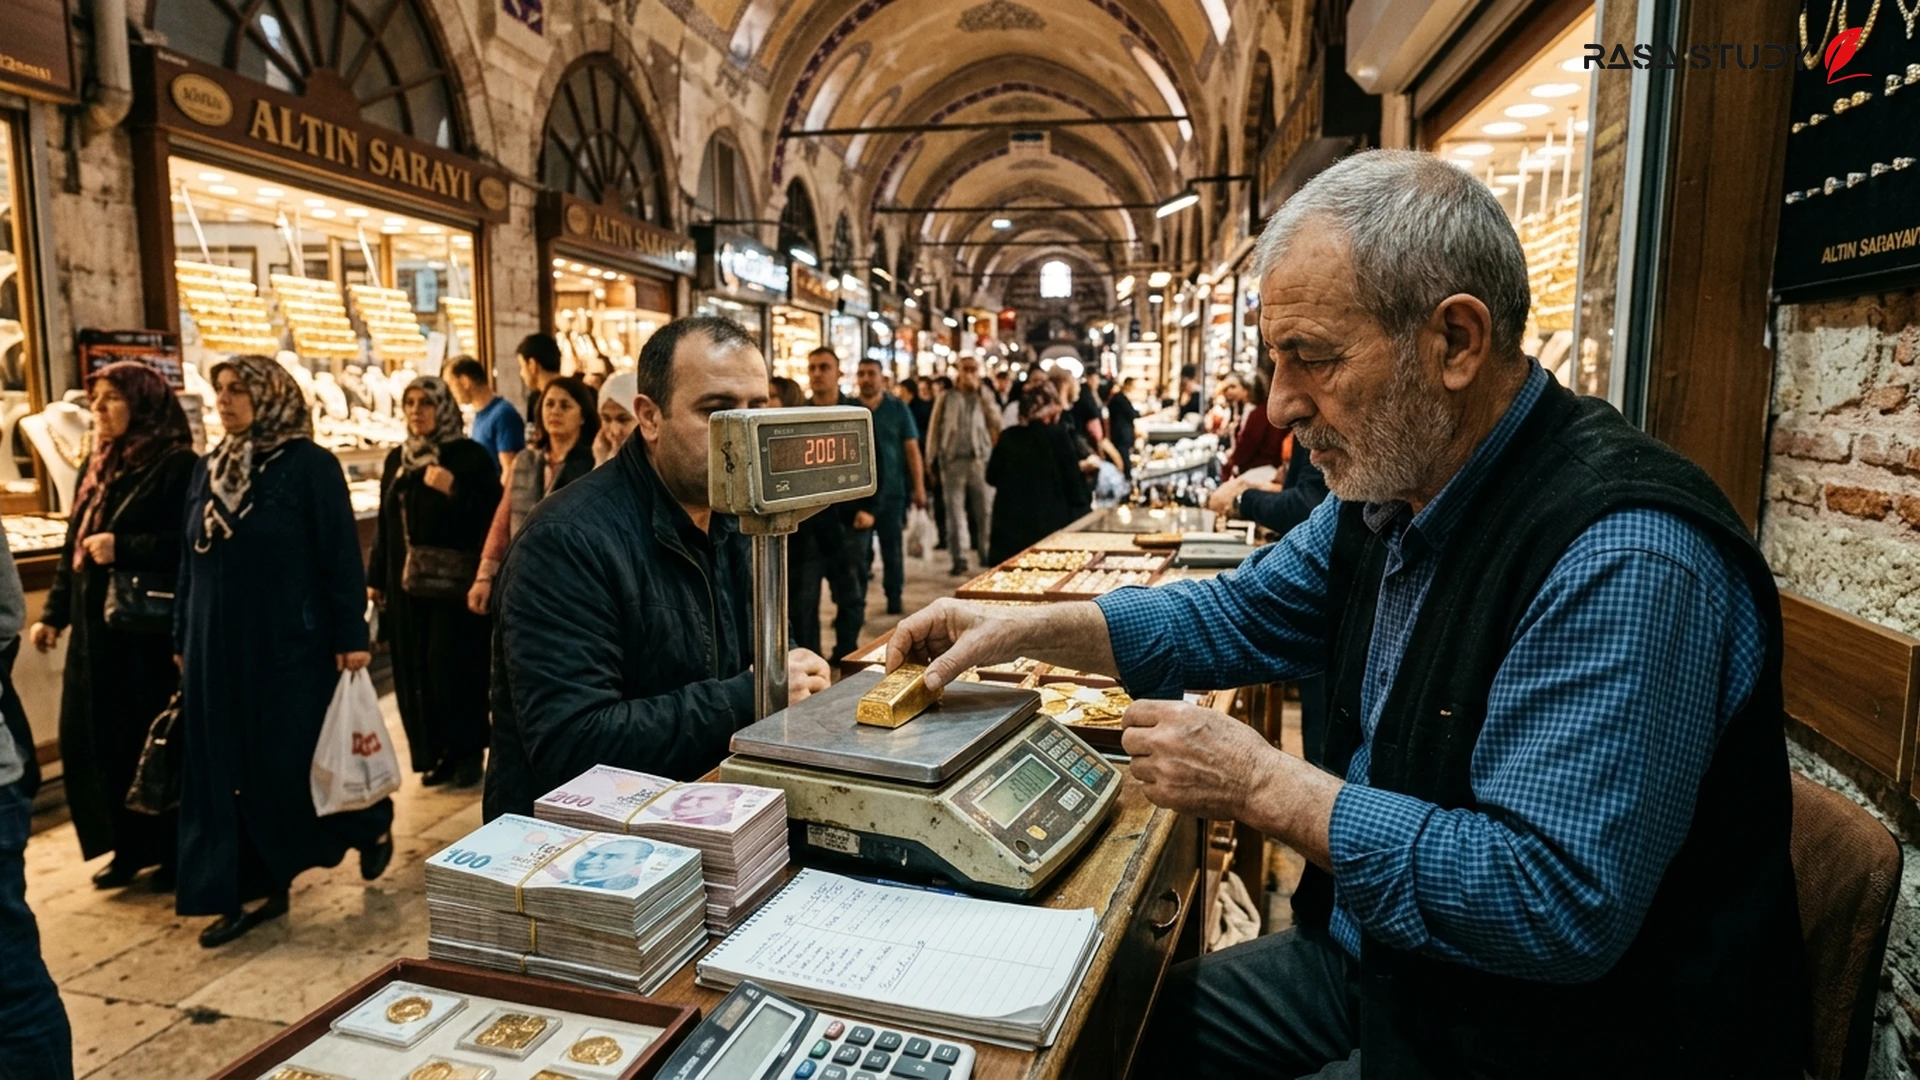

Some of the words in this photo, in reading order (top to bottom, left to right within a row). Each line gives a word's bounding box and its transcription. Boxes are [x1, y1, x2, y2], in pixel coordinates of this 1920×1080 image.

[250, 99, 359, 169] ALTIN
[368, 138, 471, 203] SARAYI
[1821, 241, 1857, 264] ALTIN
[804, 437, 847, 465] 2001
[443, 848, 492, 869] 100
